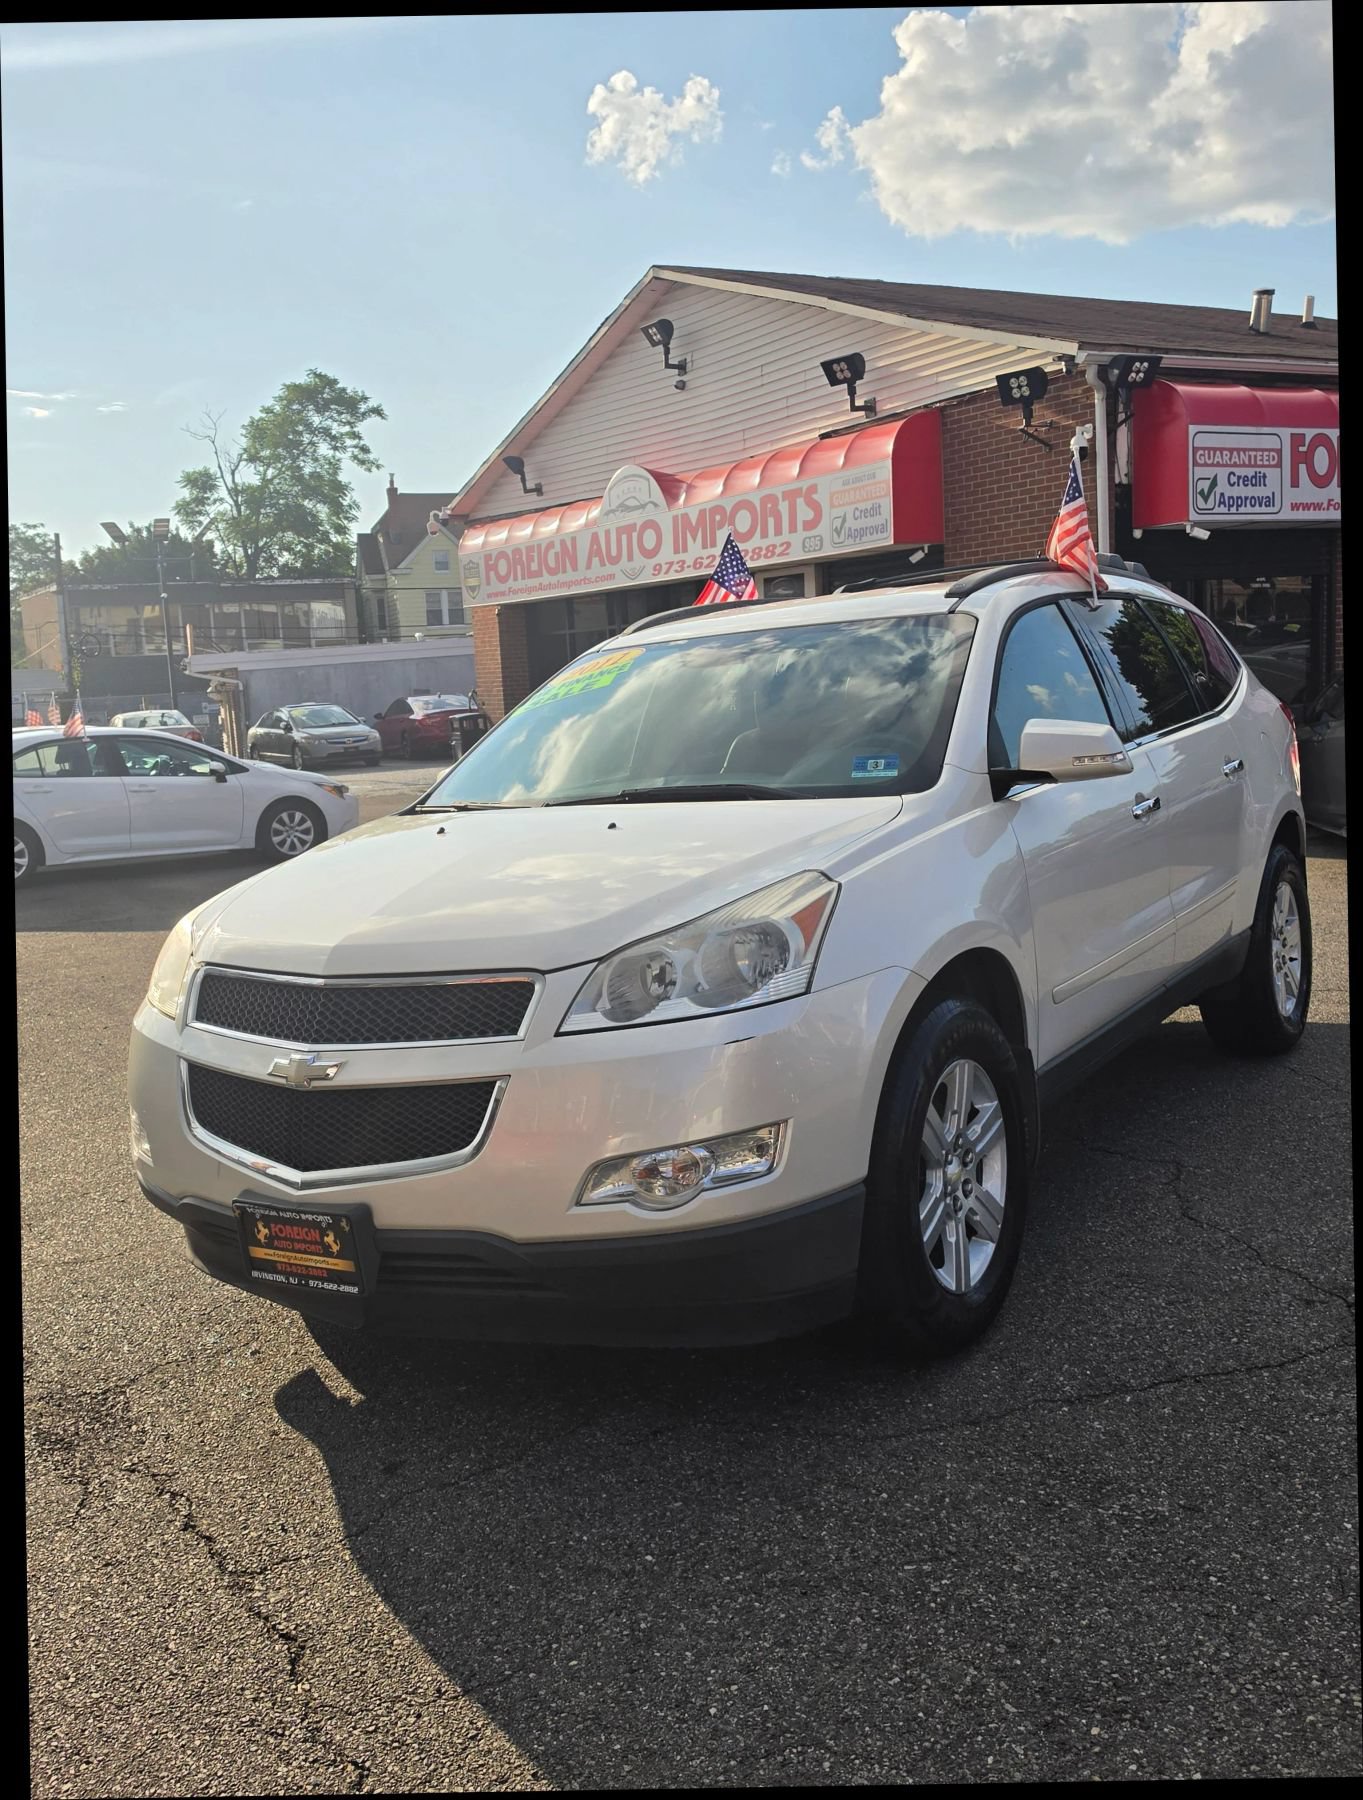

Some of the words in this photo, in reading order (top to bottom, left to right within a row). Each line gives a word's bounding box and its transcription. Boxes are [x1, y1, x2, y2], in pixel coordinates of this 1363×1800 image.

[1196, 450, 1278, 465] GUARANTEED
[1290, 433, 1340, 489] FO
[1227, 471, 1268, 487] Credit
[833, 483, 886, 505] GUARANTEED
[1218, 492, 1275, 512] Approval
[853, 502, 882, 520] Credit
[483, 536, 578, 586] FOREIGN
[585, 519, 662, 570] AUTO
[672, 483, 823, 555] IMPORTS
[847, 518, 888, 542] Approval
[486, 572, 616, 599] www.ForeignAutoImports.com
[270, 1223, 321, 1242] FOREIGN
[273, 1239, 292, 1249] AUTO
[294, 1242, 323, 1253] IMPORTS
[251, 1270, 288, 1283] IRVINGTON,
[289, 1276, 298, 1284] NJ
[308, 1279, 359, 1294] 973-622-2882
